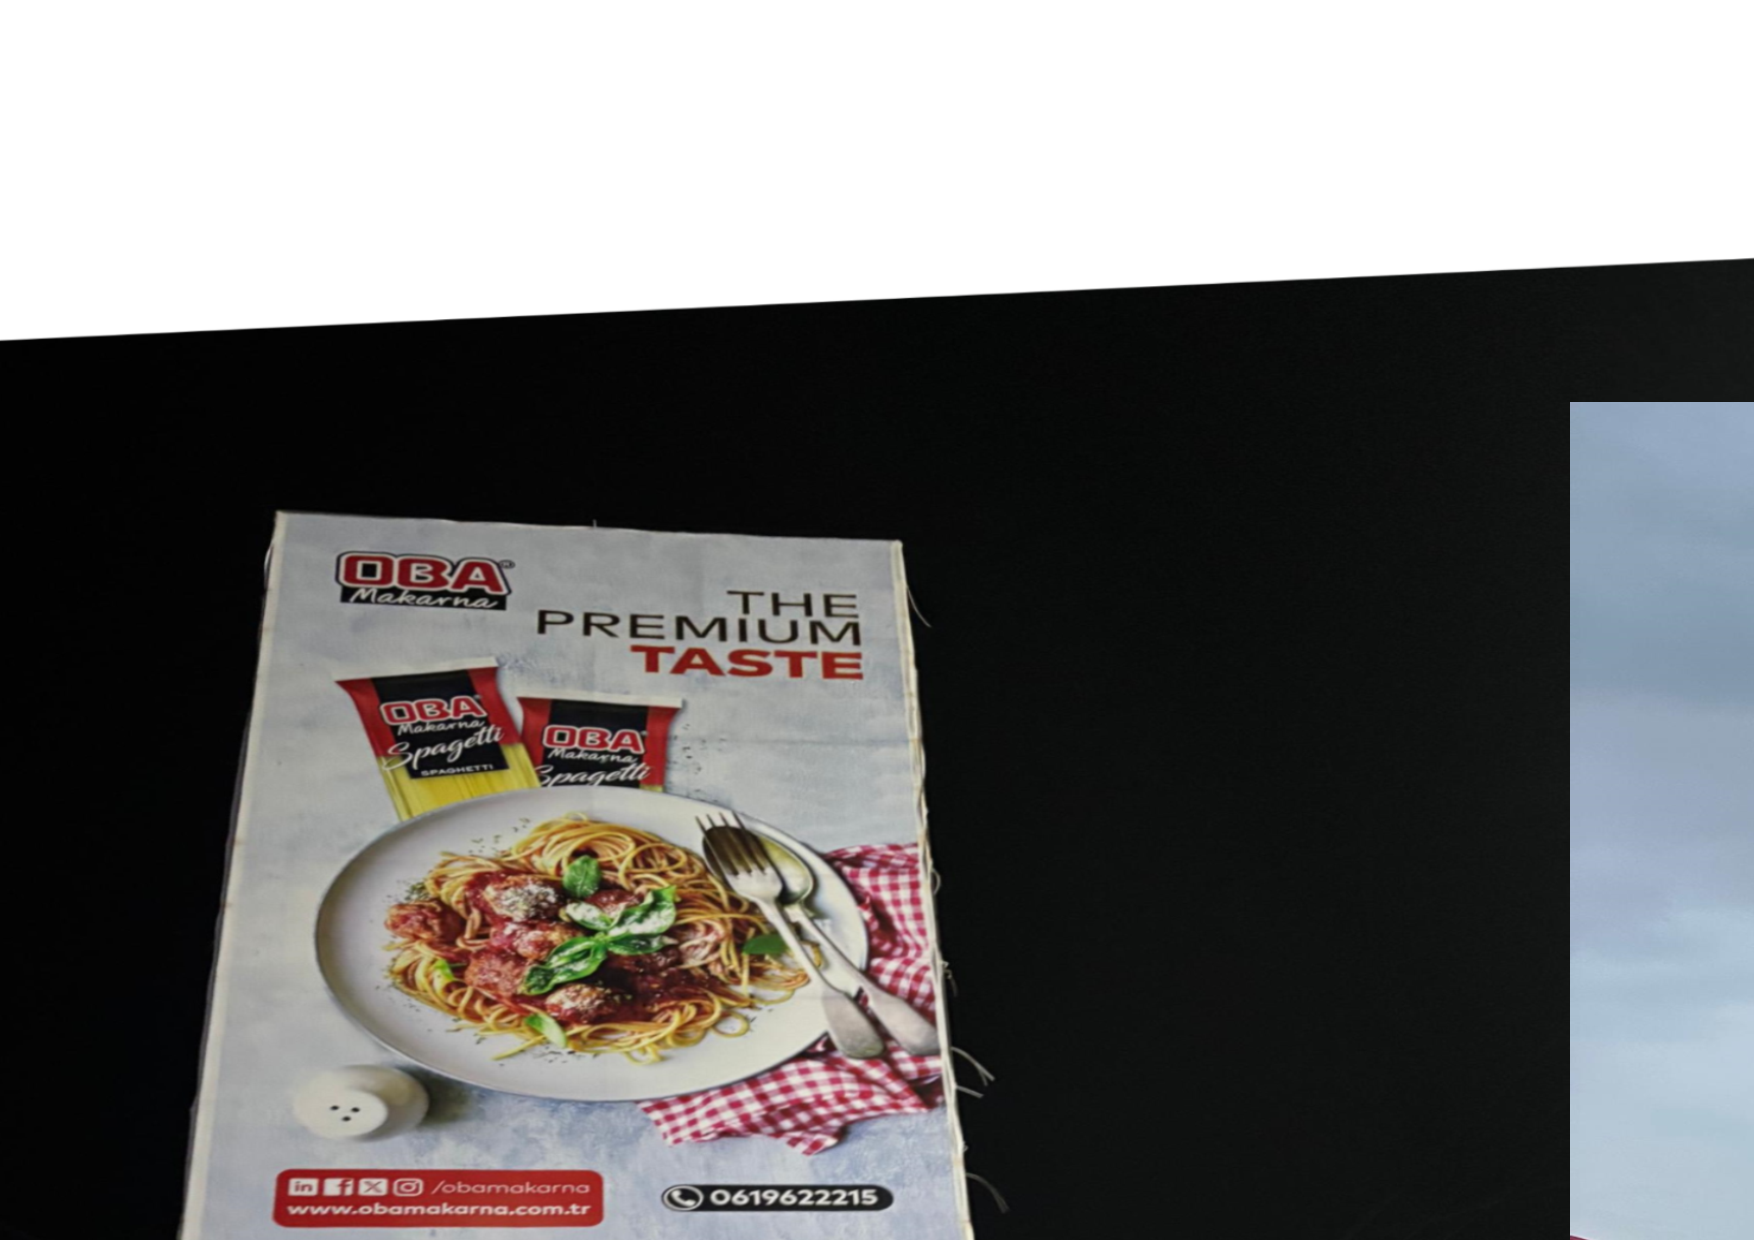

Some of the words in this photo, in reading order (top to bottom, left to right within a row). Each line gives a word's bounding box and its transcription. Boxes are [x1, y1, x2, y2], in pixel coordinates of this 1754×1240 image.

[338, 552, 510, 596] OBA
[350, 587, 498, 609] Makarna
[727, 590, 859, 618] THE
[537, 609, 861, 646] PREMIUM
[630, 645, 863, 681] TASTE
[380, 695, 488, 725] OBA
[397, 720, 485, 736] Makarna
[542, 725, 645, 754] OBA
[382, 724, 505, 770] Spagetti
[547, 747, 638, 763] Makarna
[420, 764, 494, 776] SPAGHETTI
[431, 1180, 590, 1195] /obamakarna
[710, 1189, 878, 1206] 0619622215
[287, 1203, 592, 1217] www.obamakarna.com.tr
